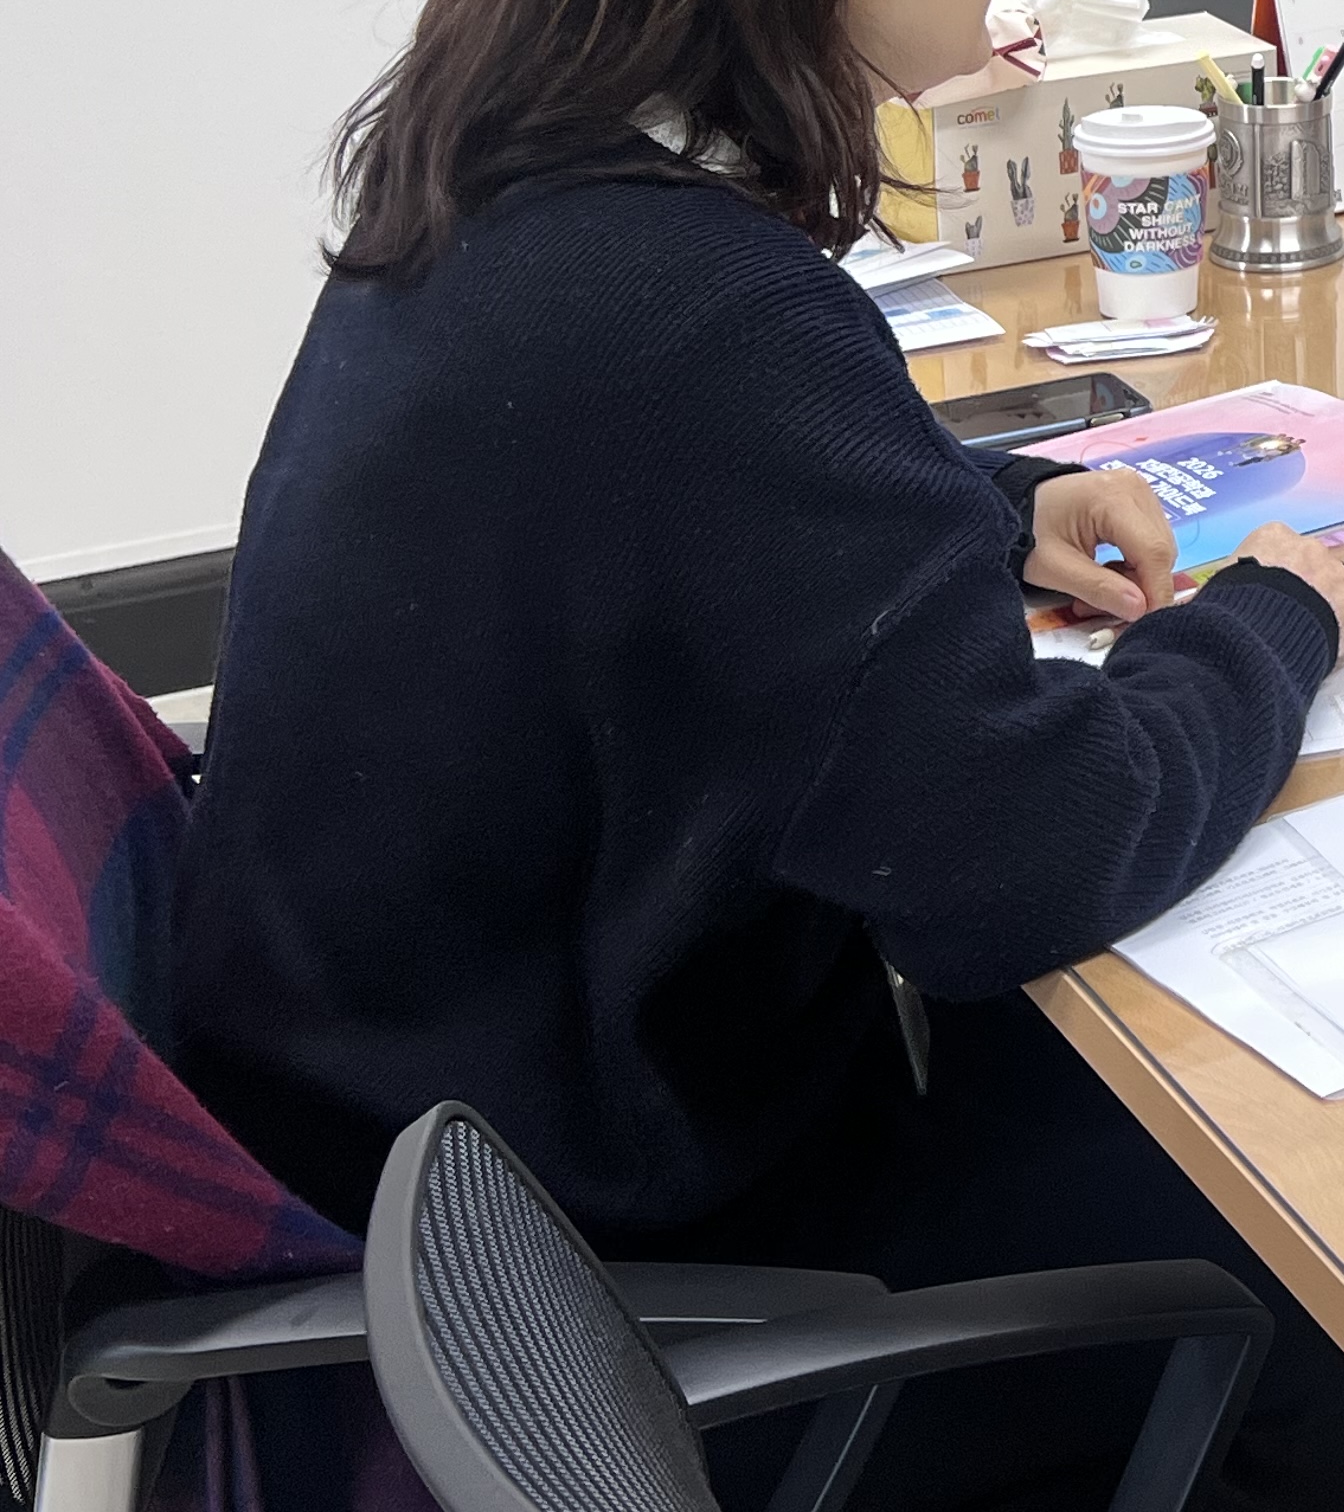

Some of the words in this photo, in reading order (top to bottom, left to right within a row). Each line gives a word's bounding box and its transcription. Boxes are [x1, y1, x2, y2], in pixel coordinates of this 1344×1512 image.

[1117, 201, 1158, 215] STAR
[1141, 211, 1184, 228] SHINE
[1129, 222, 1193, 240] WITHOUT
[1177, 457, 1224, 480] 2026
[1150, 481, 1207, 516] 가이드북
